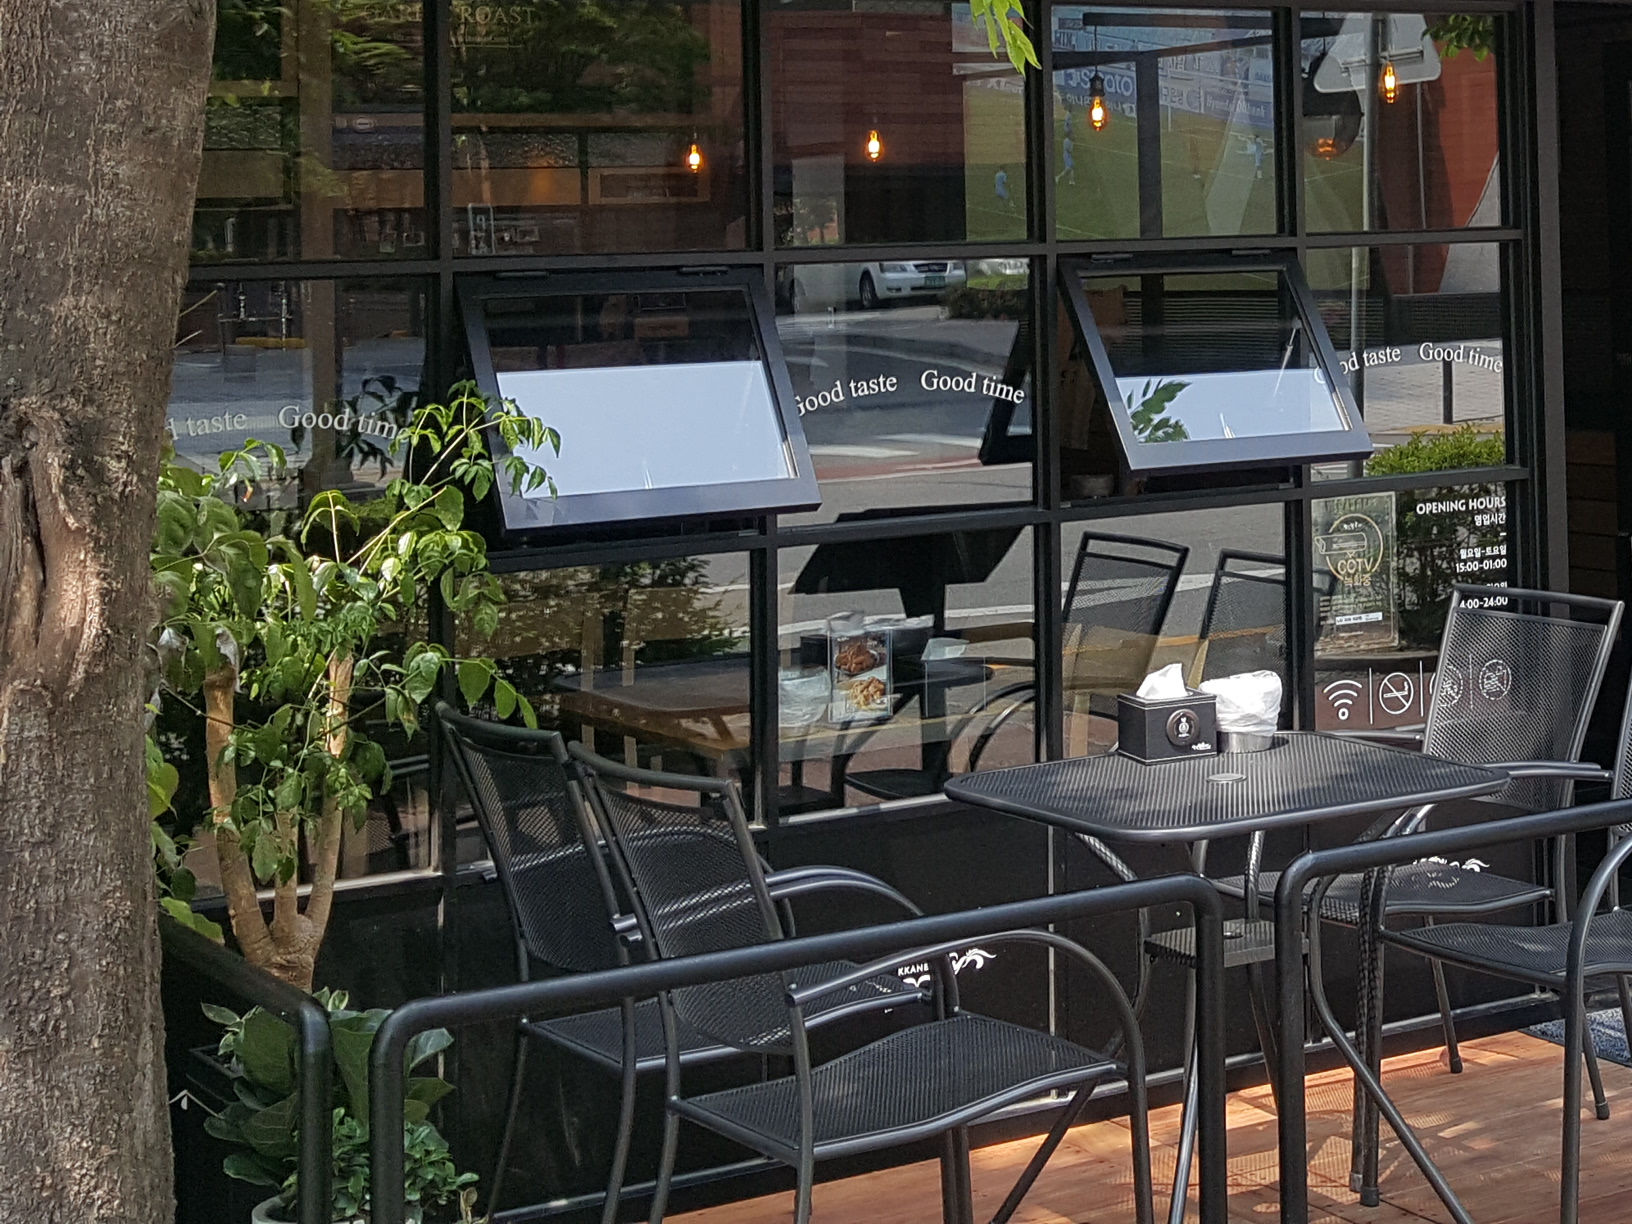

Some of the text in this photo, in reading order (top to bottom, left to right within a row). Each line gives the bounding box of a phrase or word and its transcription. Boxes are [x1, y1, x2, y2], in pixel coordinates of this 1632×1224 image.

[1363, 346, 1401, 372] taste
[1419, 342, 1464, 363] Good
[1468, 348, 1504, 374] time
[849, 374, 898, 398] taste
[920, 369, 976, 394] Good
[982, 375, 1026, 404] time
[186, 410, 247, 437] taste
[278, 405, 350, 430] Good
[1416, 496, 1507, 515] OPENING HOURS
[1474, 512, 1507, 526] 영업시간
[1337, 556, 1374, 575] CCTV
